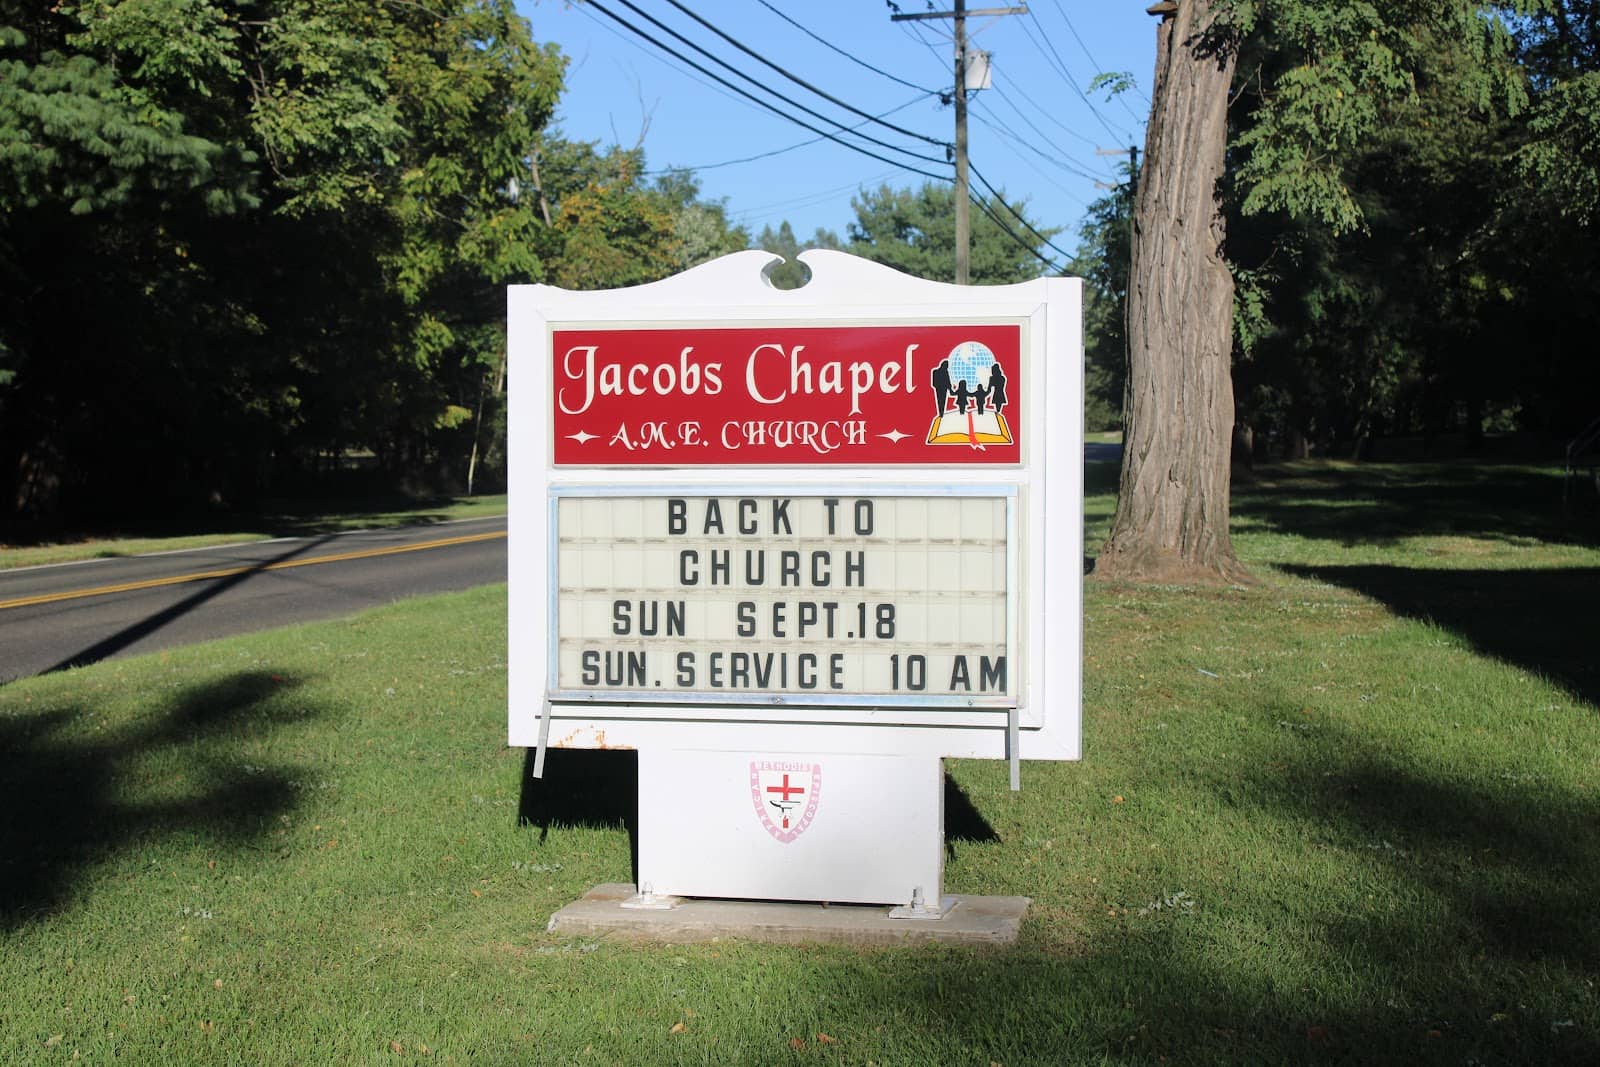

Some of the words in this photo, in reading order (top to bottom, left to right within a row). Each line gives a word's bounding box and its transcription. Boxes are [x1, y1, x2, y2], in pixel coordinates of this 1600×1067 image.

[559, 345, 723, 415] Jacobs
[746, 343, 919, 417] Chapel
[609, 421, 709, 451] A.M.E.
[722, 420, 867, 454] CHURCH
[668, 498, 793, 535] BACK
[823, 498, 874, 536] TO
[679, 549, 865, 587] CHURCH
[613, 600, 686, 637] SUN
[582, 650, 661, 688] SUN.
[676, 651, 844, 689] SERVICE
[890, 654, 926, 691] 10
[949, 654, 1007, 692] AM
